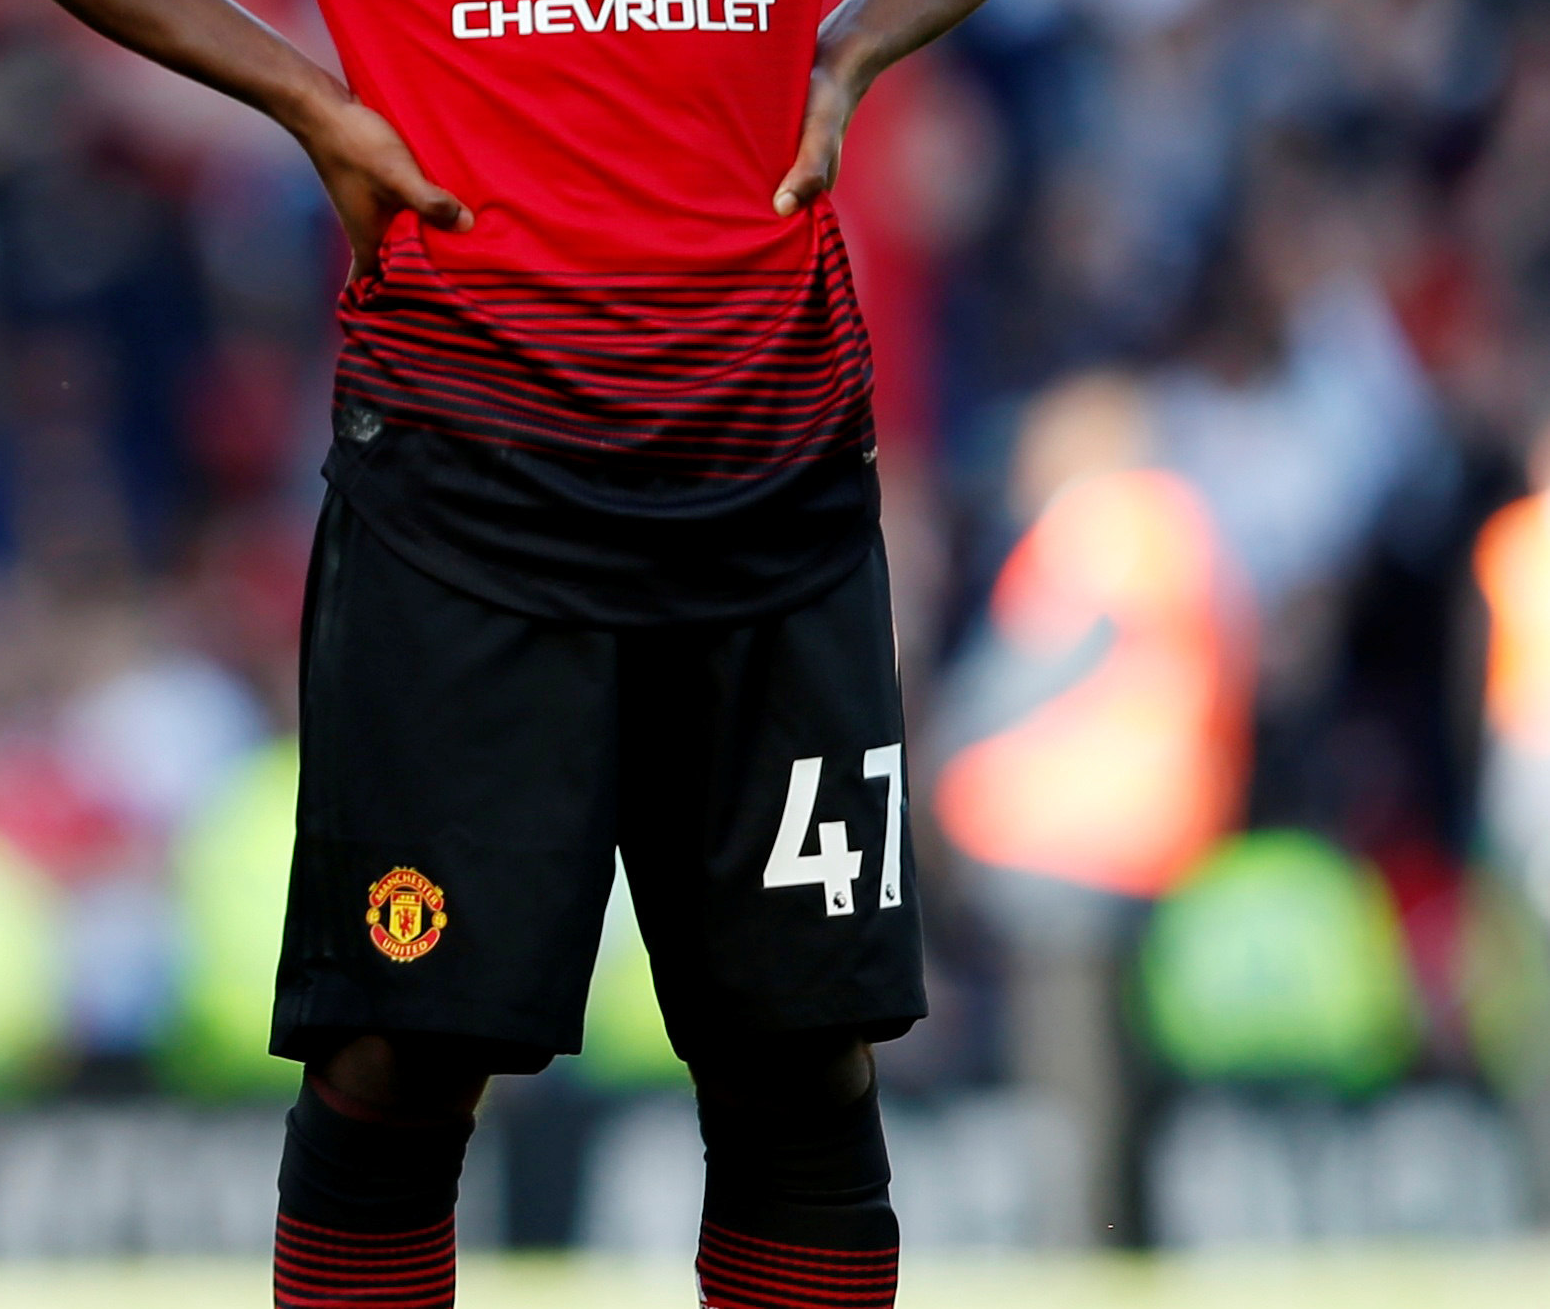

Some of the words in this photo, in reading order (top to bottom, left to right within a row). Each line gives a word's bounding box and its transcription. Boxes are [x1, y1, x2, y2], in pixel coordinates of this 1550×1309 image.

[762, 742, 902, 917] 47
[375, 873, 439, 901] MANCHESTER
[382, 937, 428, 956] UNITED
